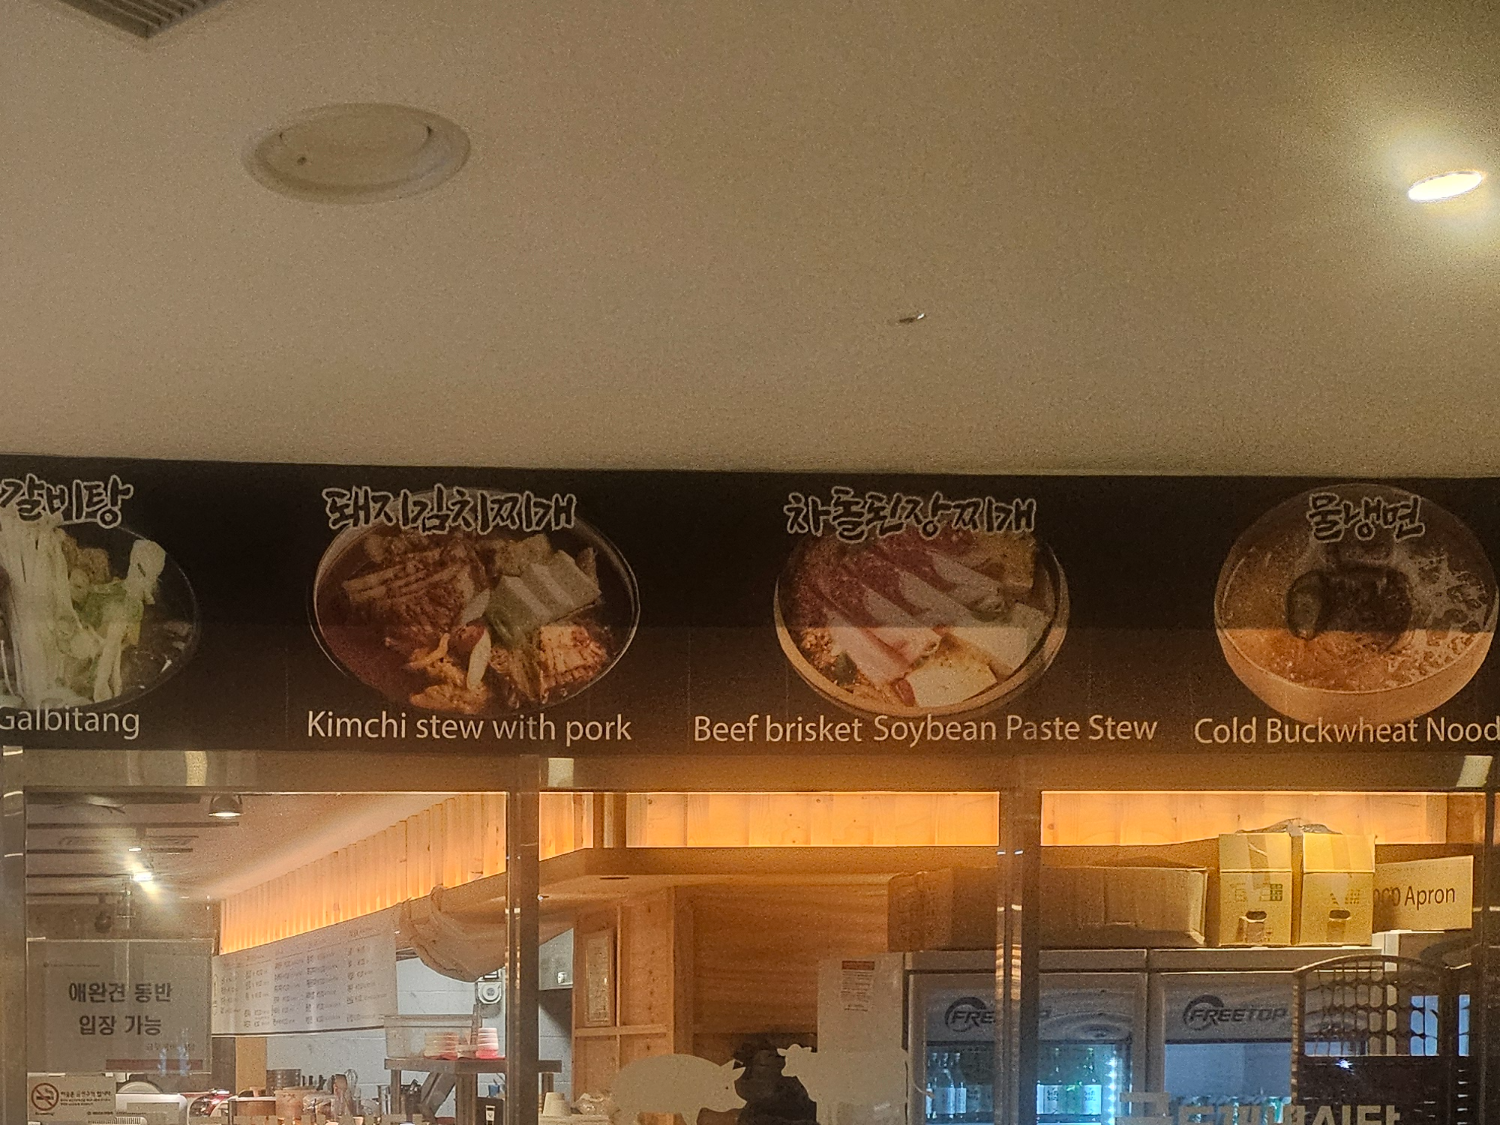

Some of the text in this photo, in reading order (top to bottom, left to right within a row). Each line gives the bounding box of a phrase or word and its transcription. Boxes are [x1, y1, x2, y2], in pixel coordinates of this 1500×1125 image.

[322, 483, 577, 536] 돼지김치찌개
[784, 486, 1037, 544] 차돌된장찌개
[1306, 492, 1426, 543] 물냉면
[307, 710, 633, 747] Kimchi stew with pork
[694, 714, 1158, 748] Beef brisket Soybean Paste Stew
[1194, 716, 1257, 744] Cold
[1266, 716, 1419, 744] Buckwheat
[1404, 885, 1456, 911] Apron
[68, 981, 173, 1003] 애완견 동반
[78, 1014, 162, 1036] 입장 가능
[1189, 1006, 1290, 1027] FREETOP
